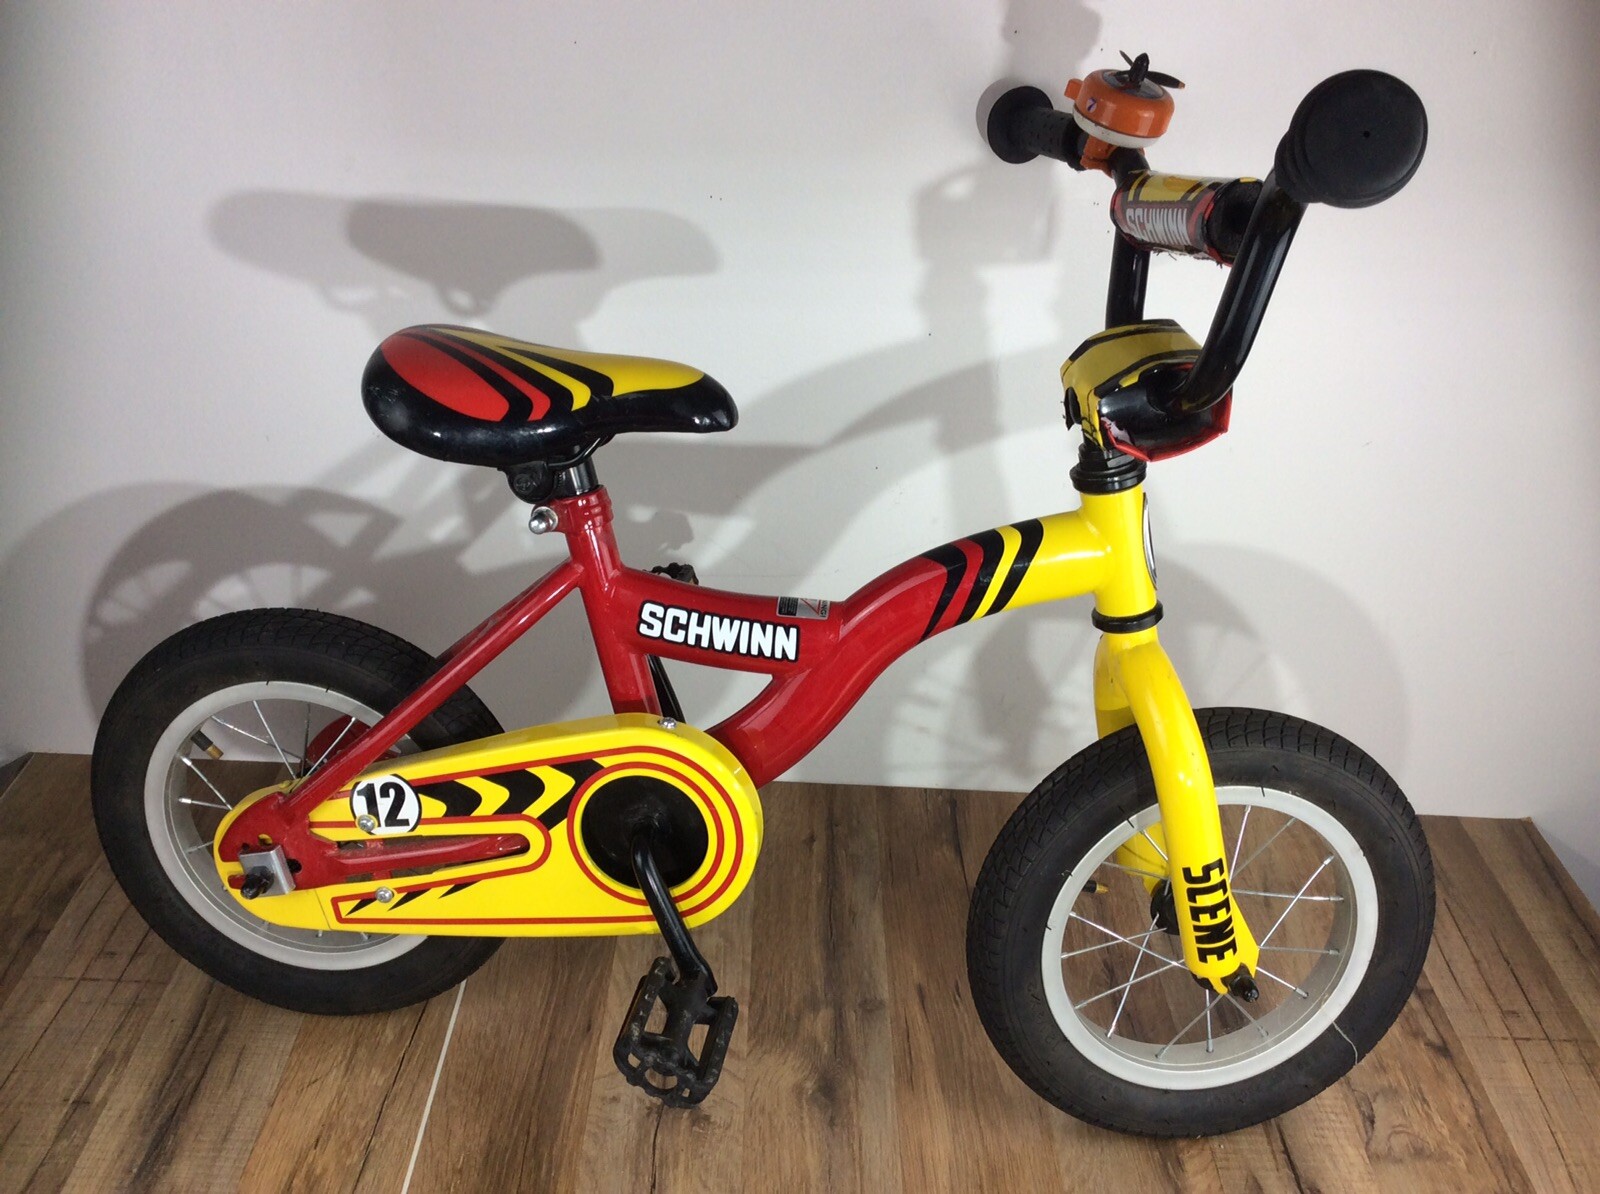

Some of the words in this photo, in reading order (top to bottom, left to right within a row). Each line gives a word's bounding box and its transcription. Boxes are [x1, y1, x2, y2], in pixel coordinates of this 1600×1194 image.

[1126, 207, 1192, 246] SCHWINN
[638, 601, 798, 662] SCHWINN
[357, 781, 410, 828] 12
[1182, 857, 1238, 964] SCENE
